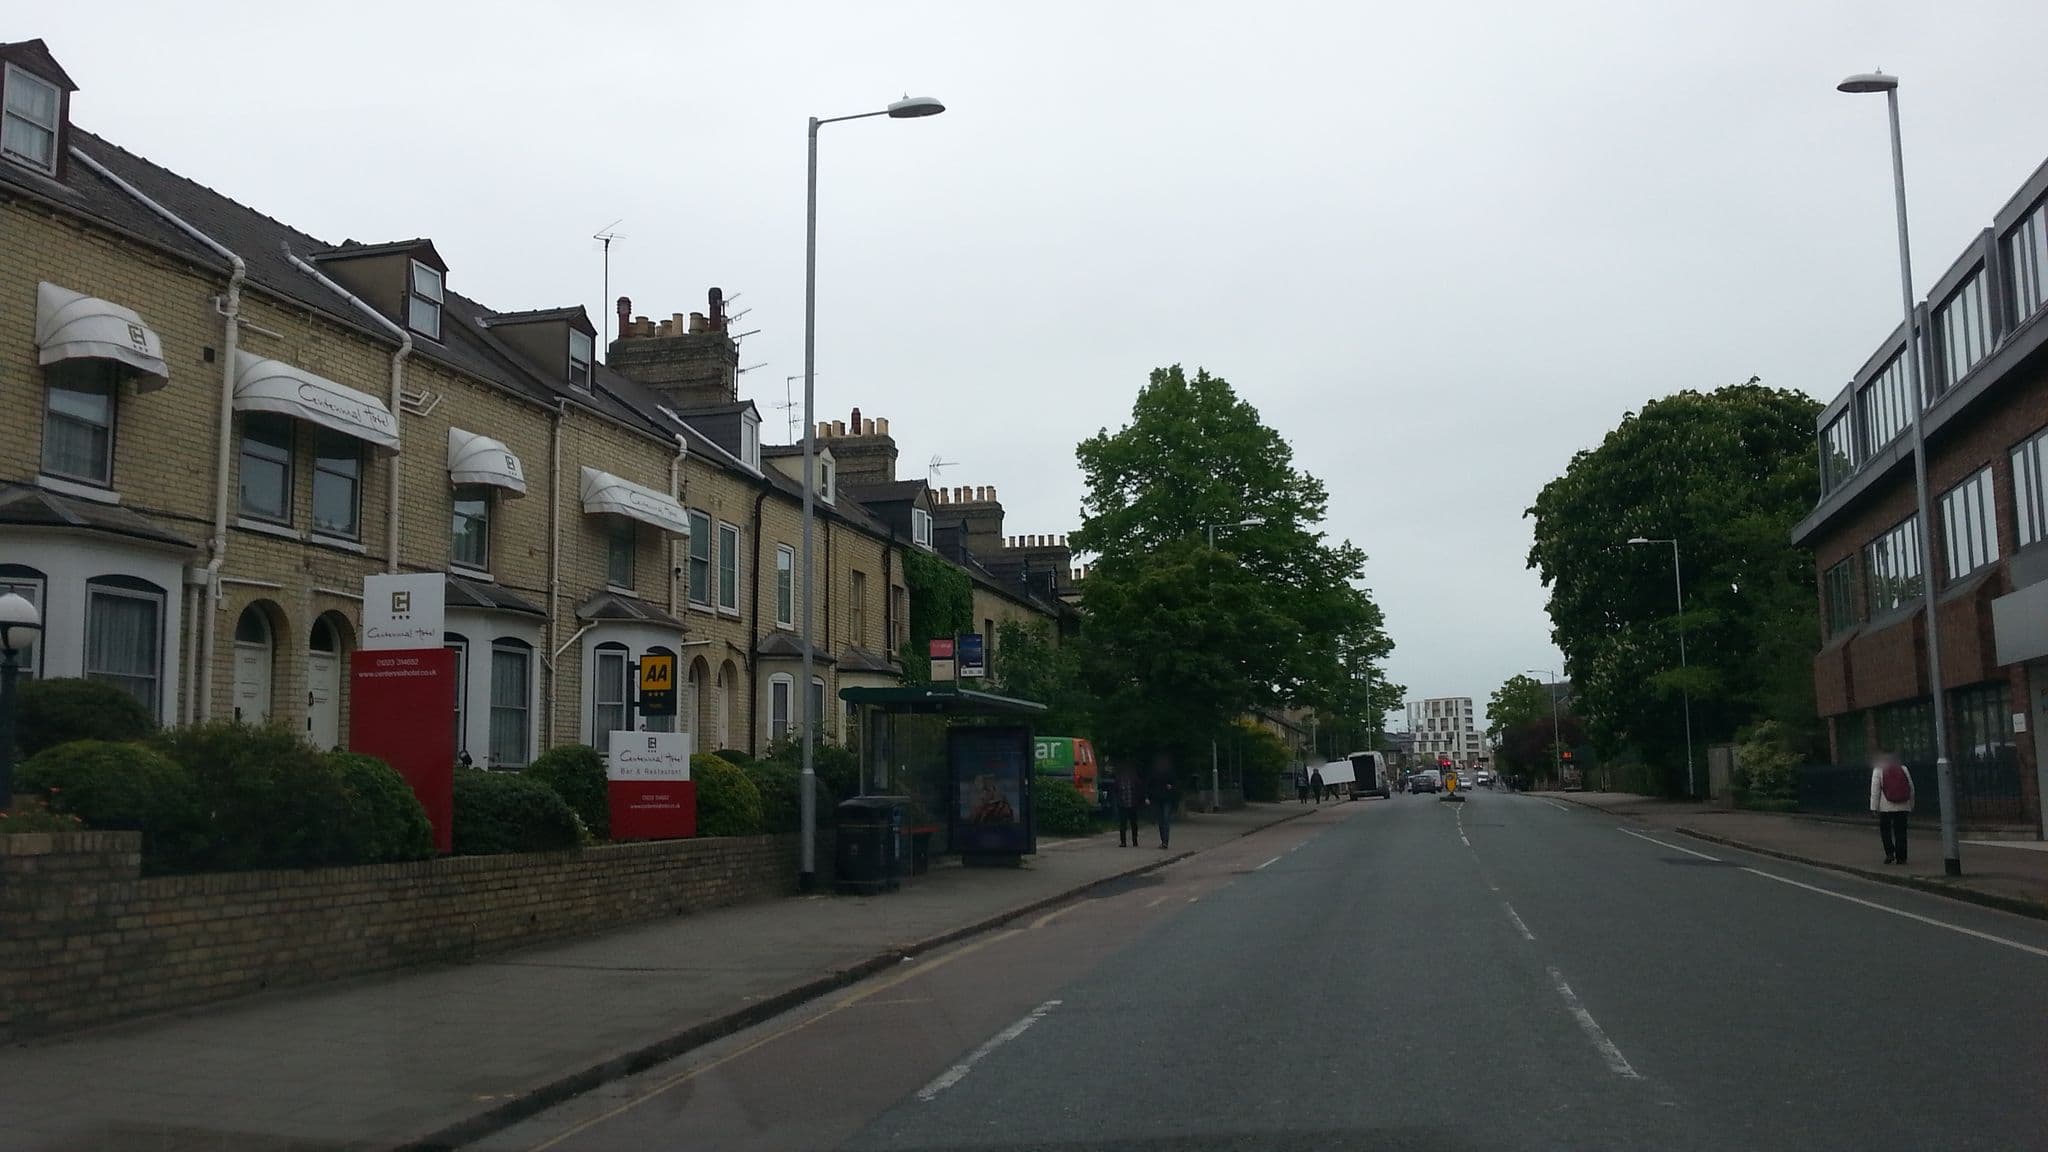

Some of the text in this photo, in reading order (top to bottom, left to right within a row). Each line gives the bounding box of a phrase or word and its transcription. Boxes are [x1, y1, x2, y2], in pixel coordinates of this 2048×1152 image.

[646, 664, 668, 682] AA
[620, 767, 632, 775] Bar
[644, 767, 682, 775] Restaurant
